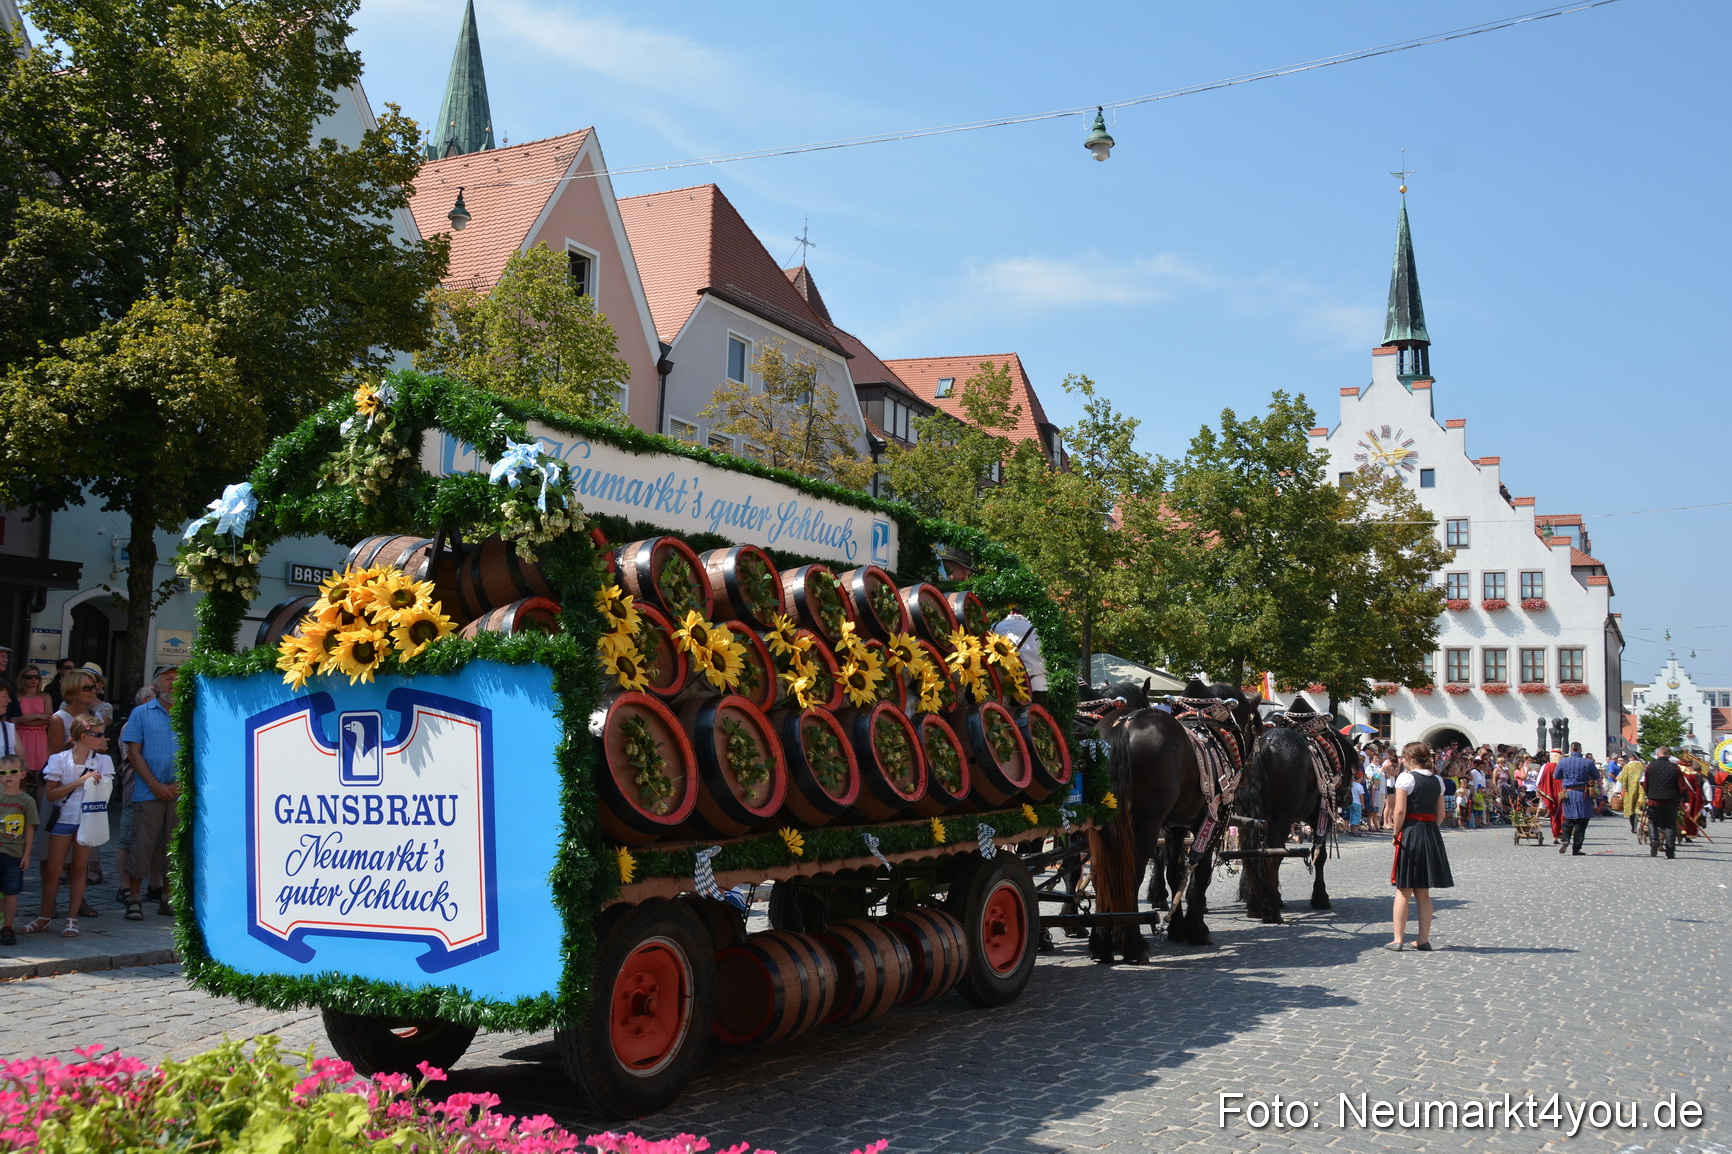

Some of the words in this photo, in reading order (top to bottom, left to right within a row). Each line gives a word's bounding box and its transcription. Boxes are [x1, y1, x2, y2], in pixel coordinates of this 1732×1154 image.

[705, 495, 773, 534] guter
[767, 500, 858, 561] Schluck
[274, 793, 459, 827] GANSBRÄU
[285, 830, 445, 877] Neumarkt's
[275, 877, 343, 916] guter
[339, 874, 459, 922] Schluck
